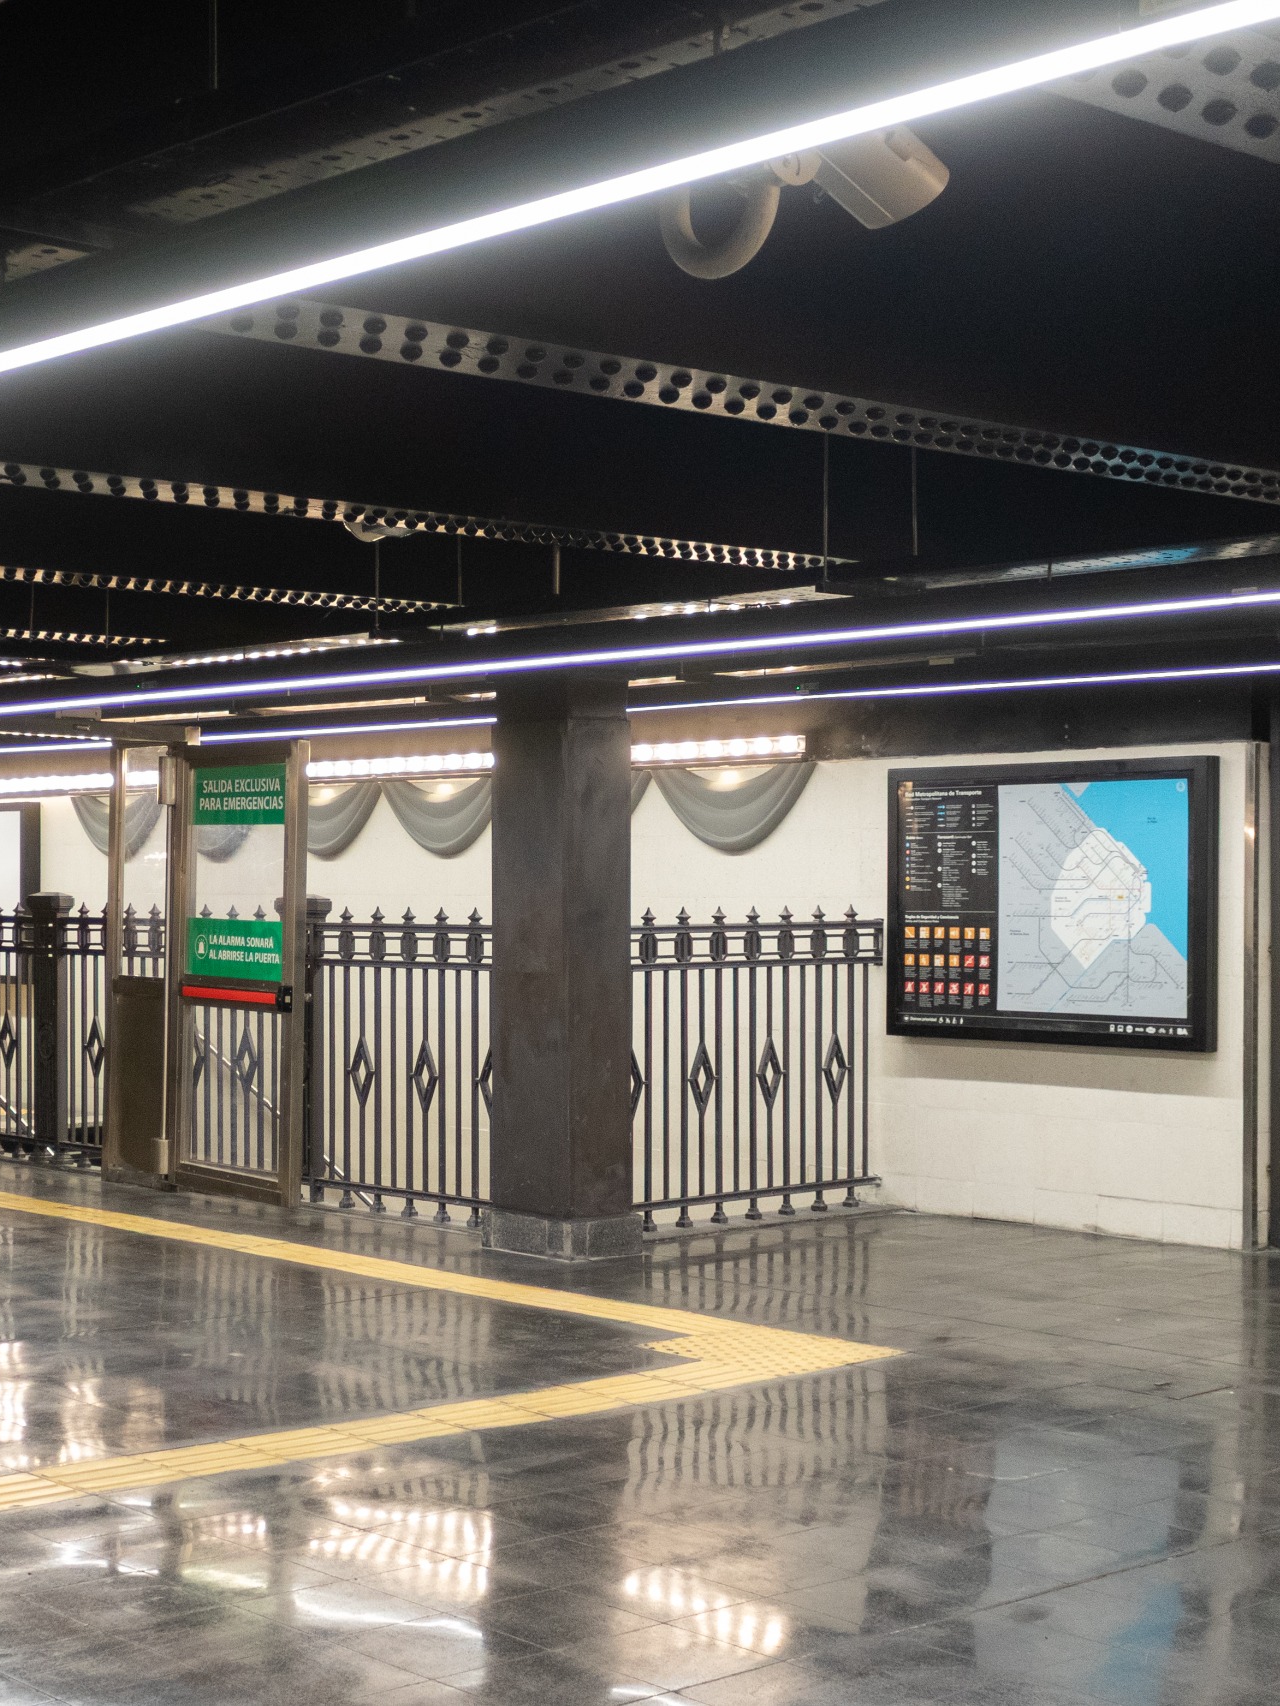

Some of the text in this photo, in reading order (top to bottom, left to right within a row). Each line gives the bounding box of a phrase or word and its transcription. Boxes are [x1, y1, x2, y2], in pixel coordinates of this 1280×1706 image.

[202, 778, 281, 793] SALIDA EXCLUSIVA
[199, 795, 284, 811] PARA EMERGENCIAS
[209, 934, 274, 949] LA ALARMA SONARÁ
[209, 948, 280, 965] AL ABRIRSE LA PUERTA
